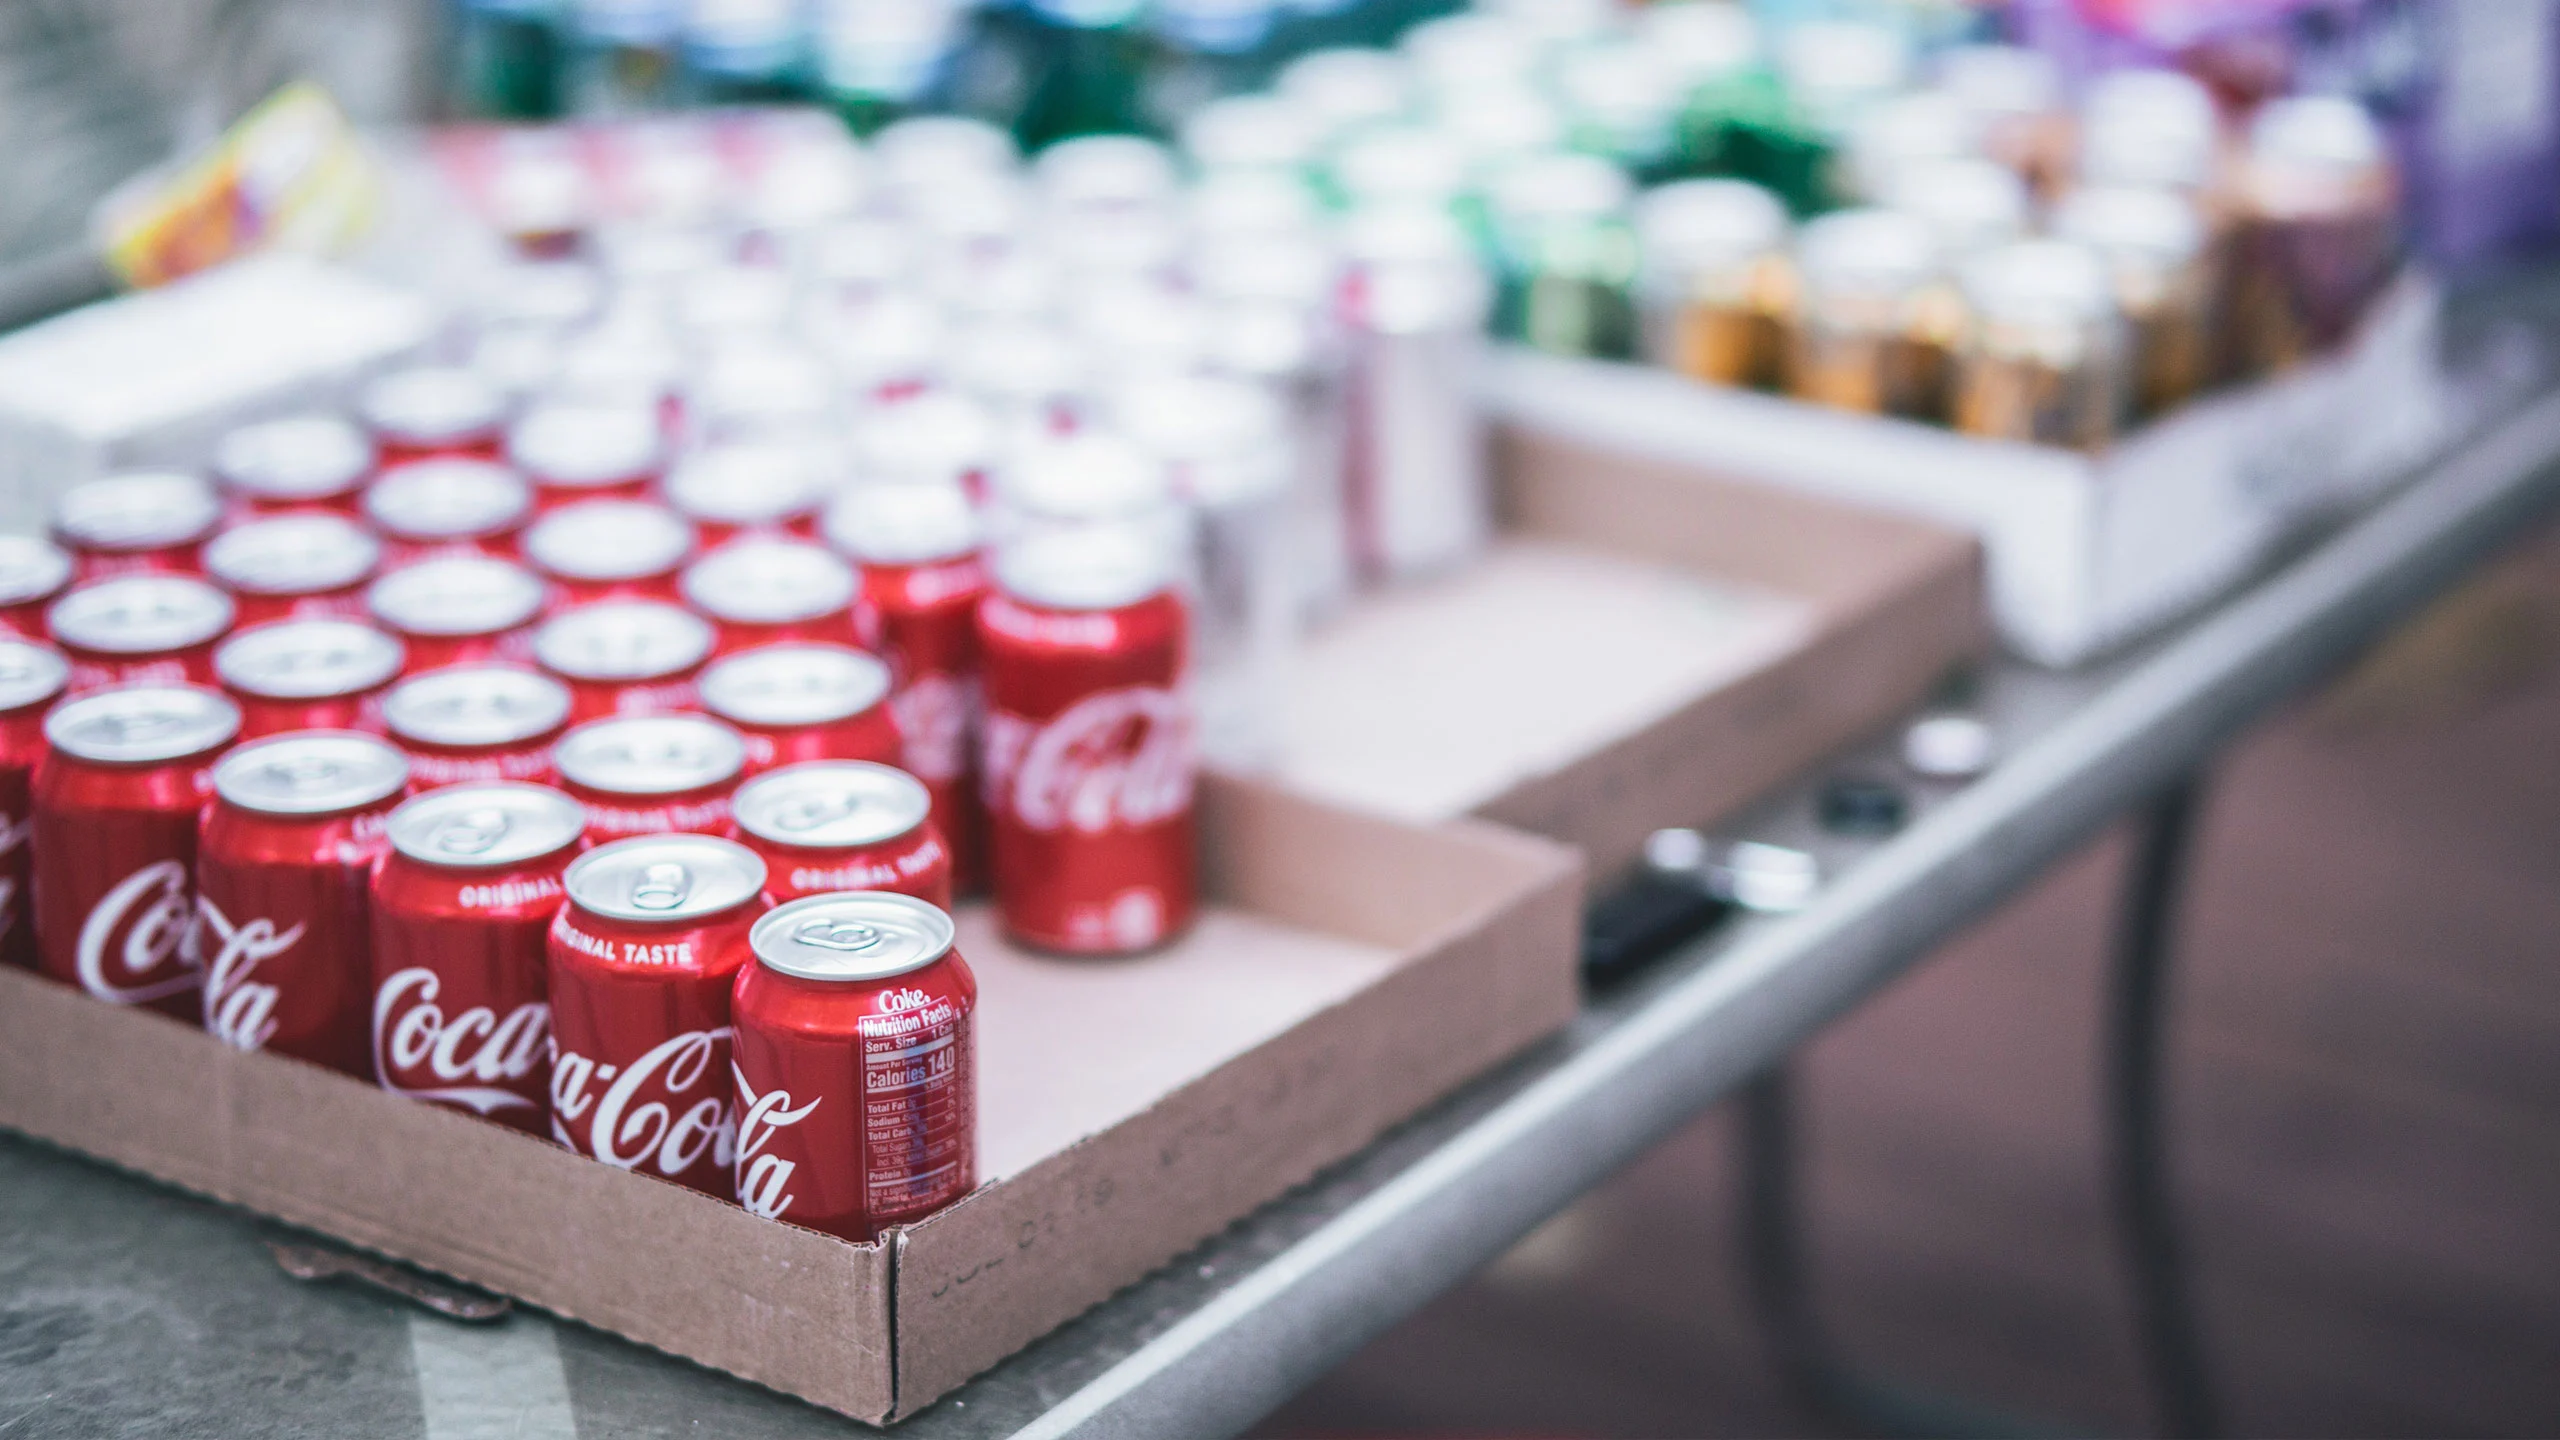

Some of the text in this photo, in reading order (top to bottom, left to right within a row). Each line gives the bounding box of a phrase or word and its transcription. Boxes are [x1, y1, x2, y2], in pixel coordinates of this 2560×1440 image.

[458, 876, 562, 908] ORIGINAL
[624, 943, 693, 966] TASTE
[863, 1003, 953, 1038] Nutrition Facts
[865, 1022, 954, 1053] Serv. Size 1 Can
[866, 1062, 889, 1071] Amount
[890, 1060, 901, 1068] Per
[866, 1045, 955, 1088] Calories 140
[867, 1103, 889, 1114] Total
[892, 1101, 906, 1111] Fat
[867, 1117, 900, 1128] Sodium
[868, 1130, 890, 1141] Total
[872, 1143, 889, 1153] Total
[869, 1170, 902, 1181] Protein
